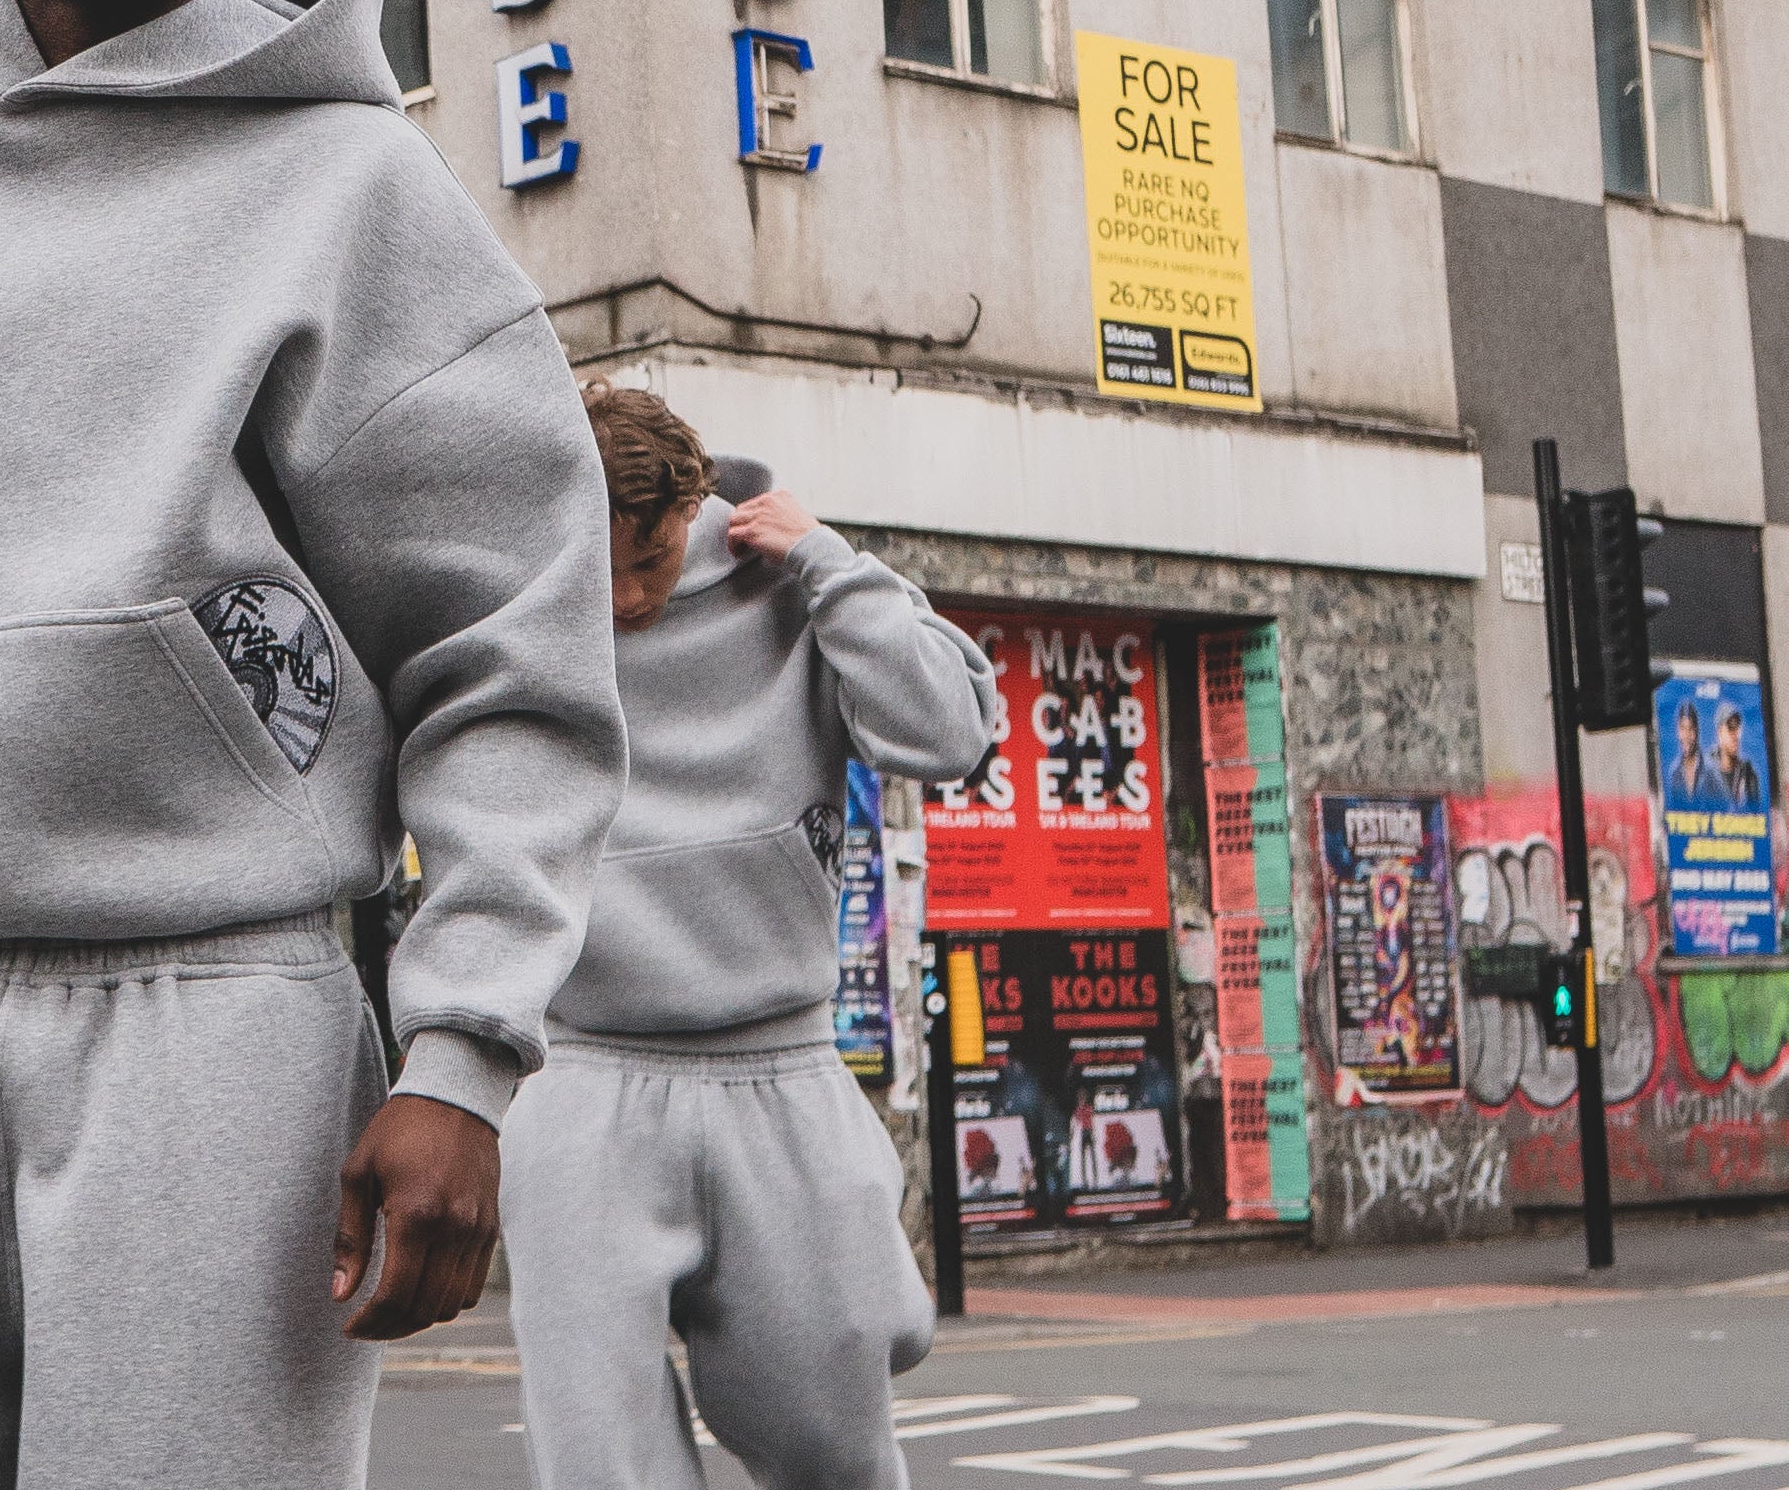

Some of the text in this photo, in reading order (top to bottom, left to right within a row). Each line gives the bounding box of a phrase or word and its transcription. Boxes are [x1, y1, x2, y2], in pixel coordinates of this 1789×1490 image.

[1119, 54, 1201, 111] FOR
[1114, 106, 1214, 165] SALE
[1122, 168, 1175, 197] RARE
[1114, 192, 1221, 230] PURCHASE
[1098, 217, 1240, 258] OPPORTUNITY
[1109, 280, 1238, 319] 26,755 SQ FT
[1024, 628, 1143, 684] MAC
[1031, 693, 1146, 748] CAB
[1036, 758, 1151, 812] EES
[1216, 822, 1284, 838] FESTIVAL
[1069, 940, 1137, 971] THE
[1221, 959, 1291, 973] FESTIVAL
[1050, 973, 1158, 1009] KOOKS
[1231, 1112, 1299, 1127] FESTIVAL
